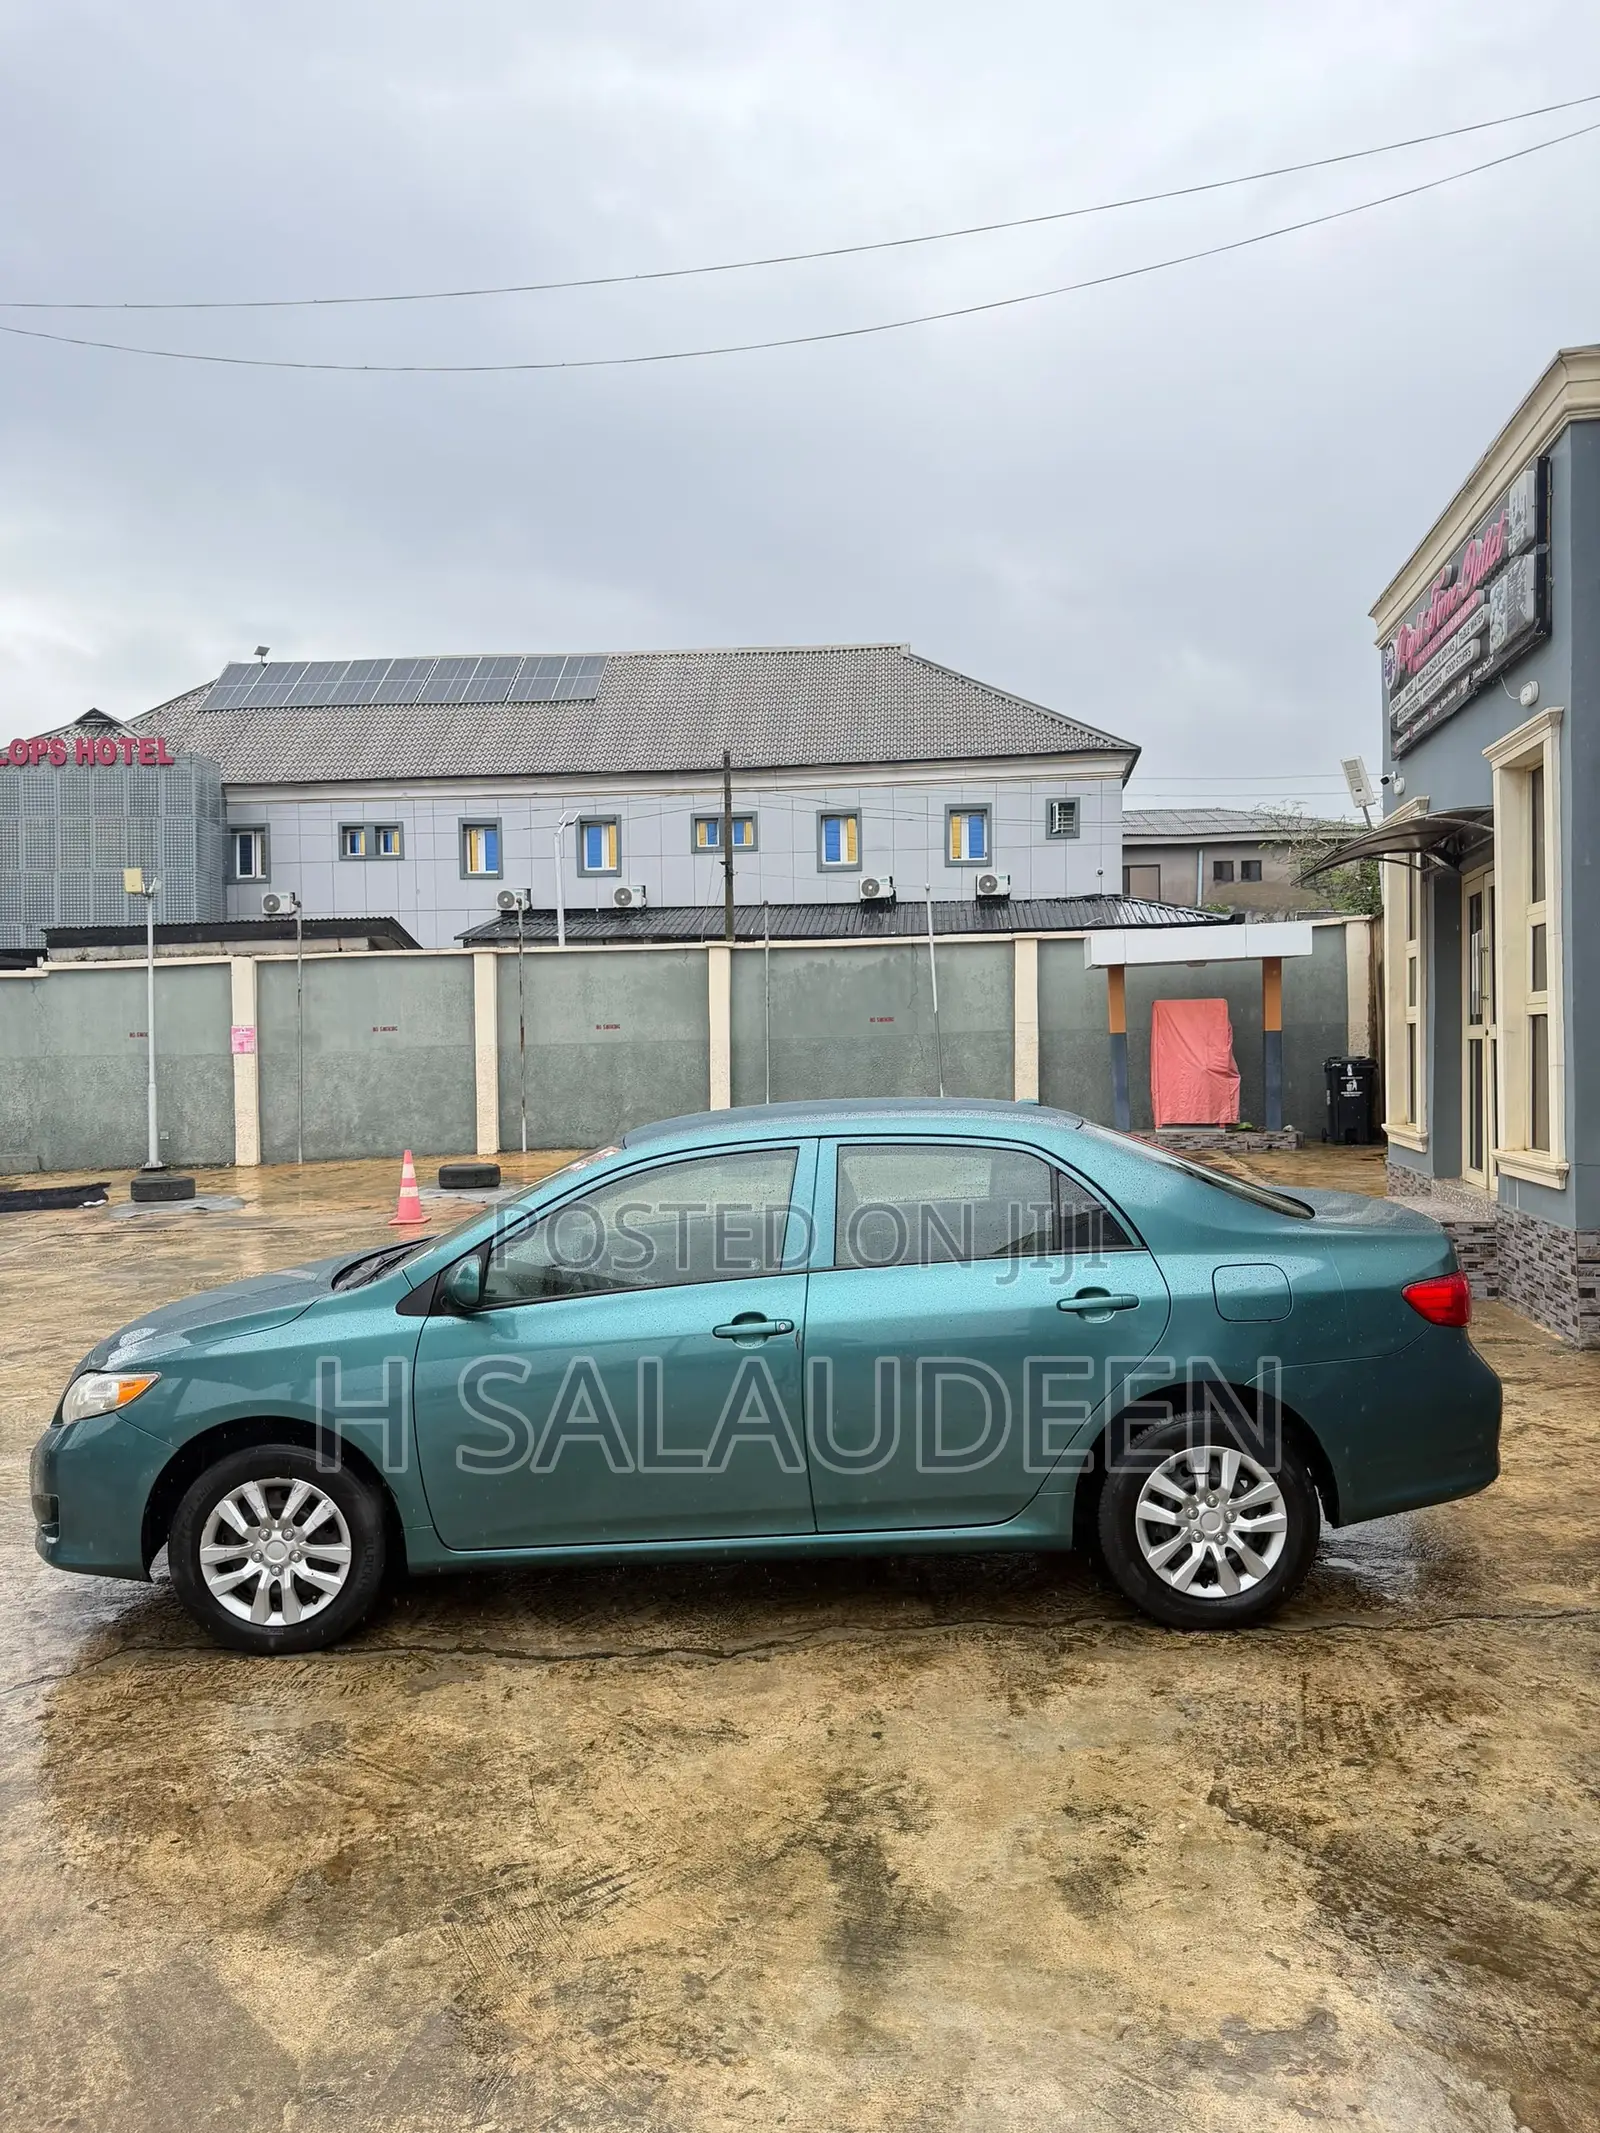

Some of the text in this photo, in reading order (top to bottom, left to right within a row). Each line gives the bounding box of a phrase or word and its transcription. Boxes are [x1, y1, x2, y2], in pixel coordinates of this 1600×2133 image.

[1461, 509, 1505, 598] Outlet
[1457, 607, 1484, 645] TABLE WATER
[75, 736, 174, 766] HOTEL
